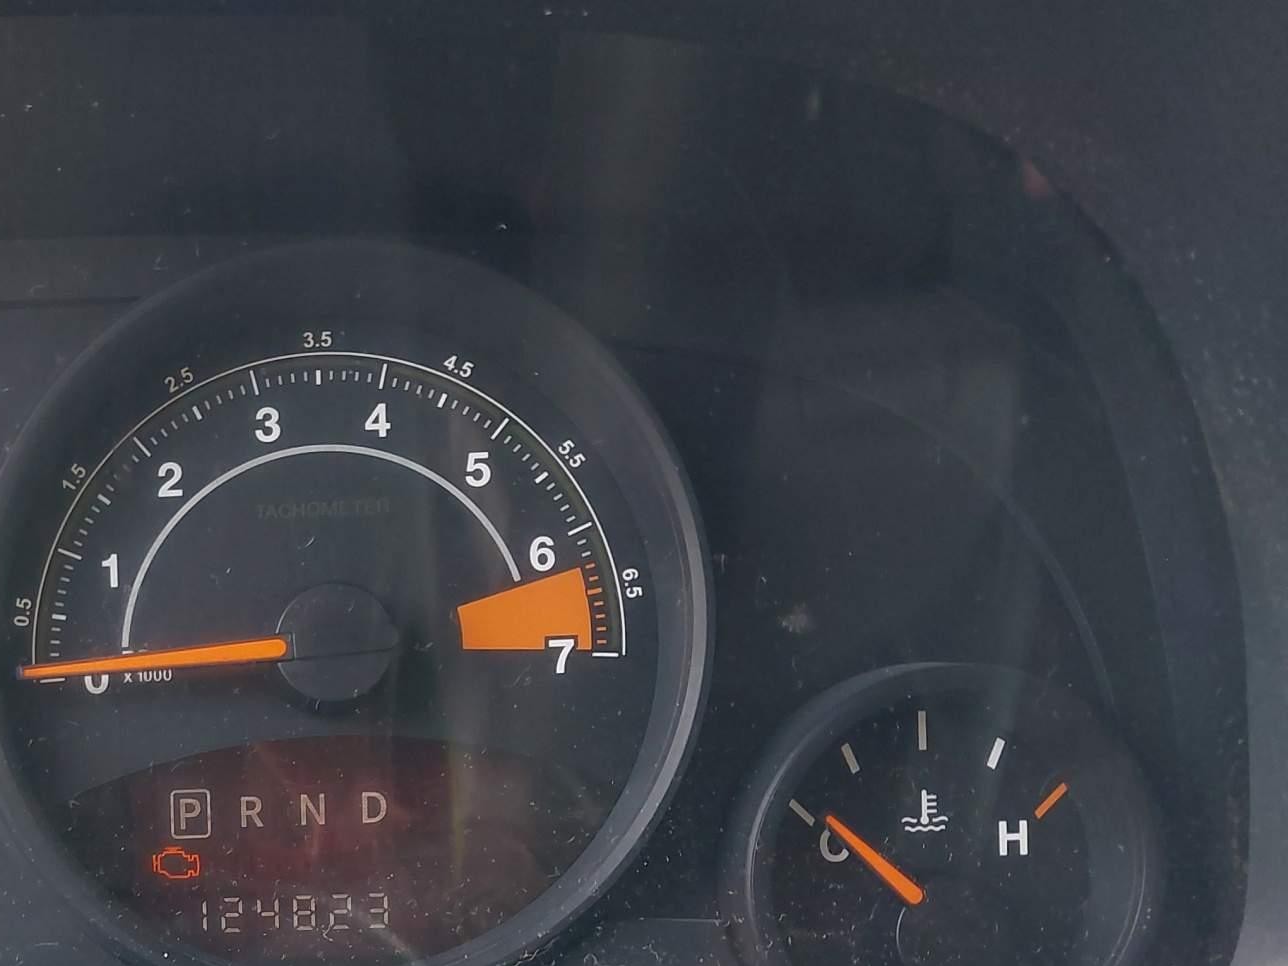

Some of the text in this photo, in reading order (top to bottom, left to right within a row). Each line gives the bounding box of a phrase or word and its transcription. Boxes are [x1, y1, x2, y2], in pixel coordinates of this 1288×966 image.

[304, 332, 331, 347] 3.5
[165, 366, 194, 394] 2.5
[443, 355, 474, 379] 4.5
[255, 407, 280, 442] 3
[365, 403, 390, 437] 4
[466, 452, 490, 487] 5
[558, 438, 586, 469] 5.5
[62, 463, 88, 493] 1.5
[158, 462, 182, 497] 2
[530, 536, 555, 571] 6
[102, 554, 118, 587] 1
[621, 568, 642, 600] 6.5
[14, 598, 31, 626] 0.5
[549, 639, 574, 673] 7
[138, 669, 173, 683] 1000
[180, 792, 386, 829] P R N D
[820, 830, 849, 862] C
[999, 820, 1027, 855] H
[200, 892, 389, 932] 124823
